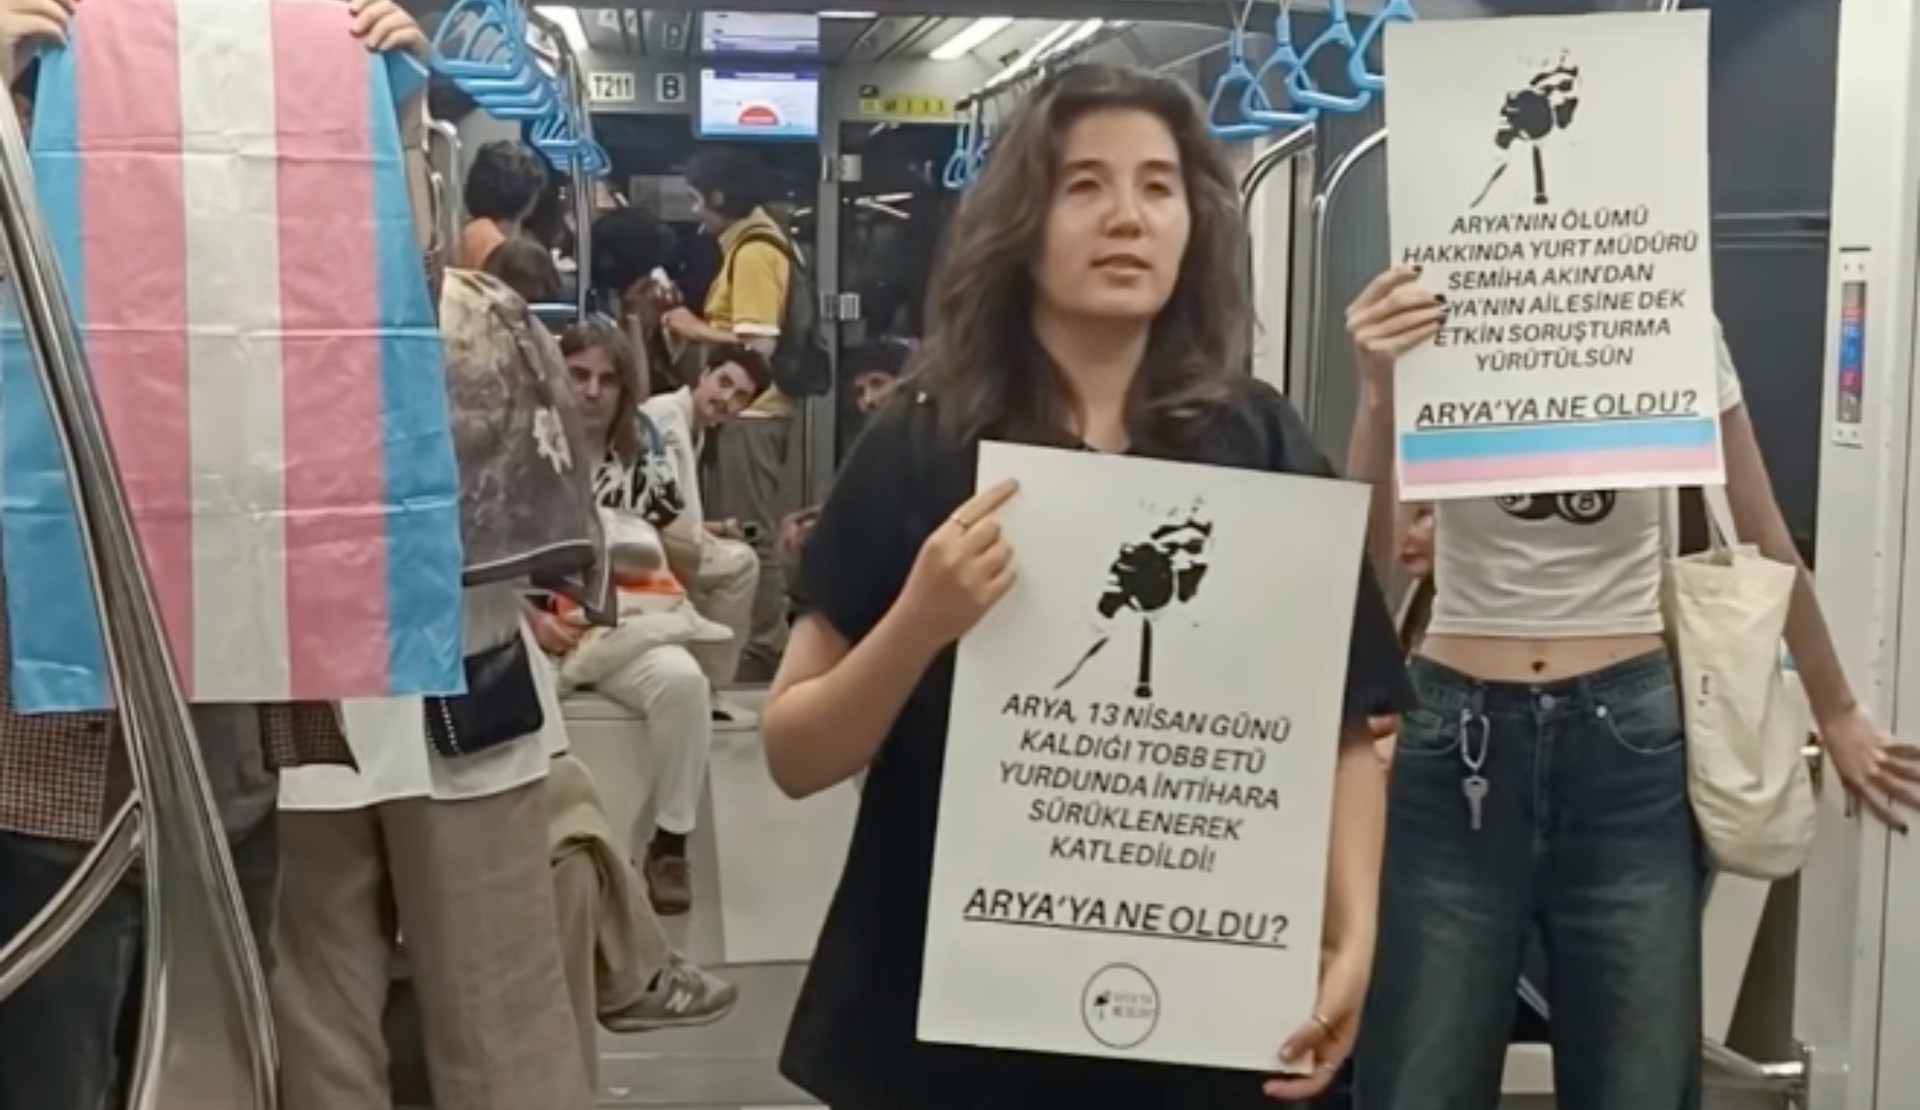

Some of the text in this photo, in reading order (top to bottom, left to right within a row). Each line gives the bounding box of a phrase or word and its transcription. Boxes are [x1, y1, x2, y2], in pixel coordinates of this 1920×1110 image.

[593, 75, 631, 97] T211
[663, 75, 678, 99] B
[1450, 205, 1648, 235] ARYA'NIN ÖLÜMÜ
[1402, 230, 1698, 263] HAKKINDA YURT MÜDÜRÜ
[1448, 263, 1653, 290] SEMİHA AKIN'DAN
[1441, 289, 1686, 318] YA'NIN AİLESİNE DEK
[1434, 318, 1671, 346] ETKİN SORUŞTURMA
[1475, 345, 1633, 372] YÜRÜTÜLSÜN
[1416, 390, 1698, 426] ARYA'YA NE OLDU?
[1001, 693, 1291, 743] ARYA, 13 NİSAN GÜNÜ
[1019, 729, 1266, 775] KALDIĞI TOBB ETÜ
[1000, 761, 1281, 810] YURDUNDA İNTİHARA
[1028, 797, 1244, 840] SÜRÜKLENEREK
[1050, 835, 1216, 873] KATLEDİLDİ!
[963, 887, 1289, 944] ARYA'YA NE OLDU?
